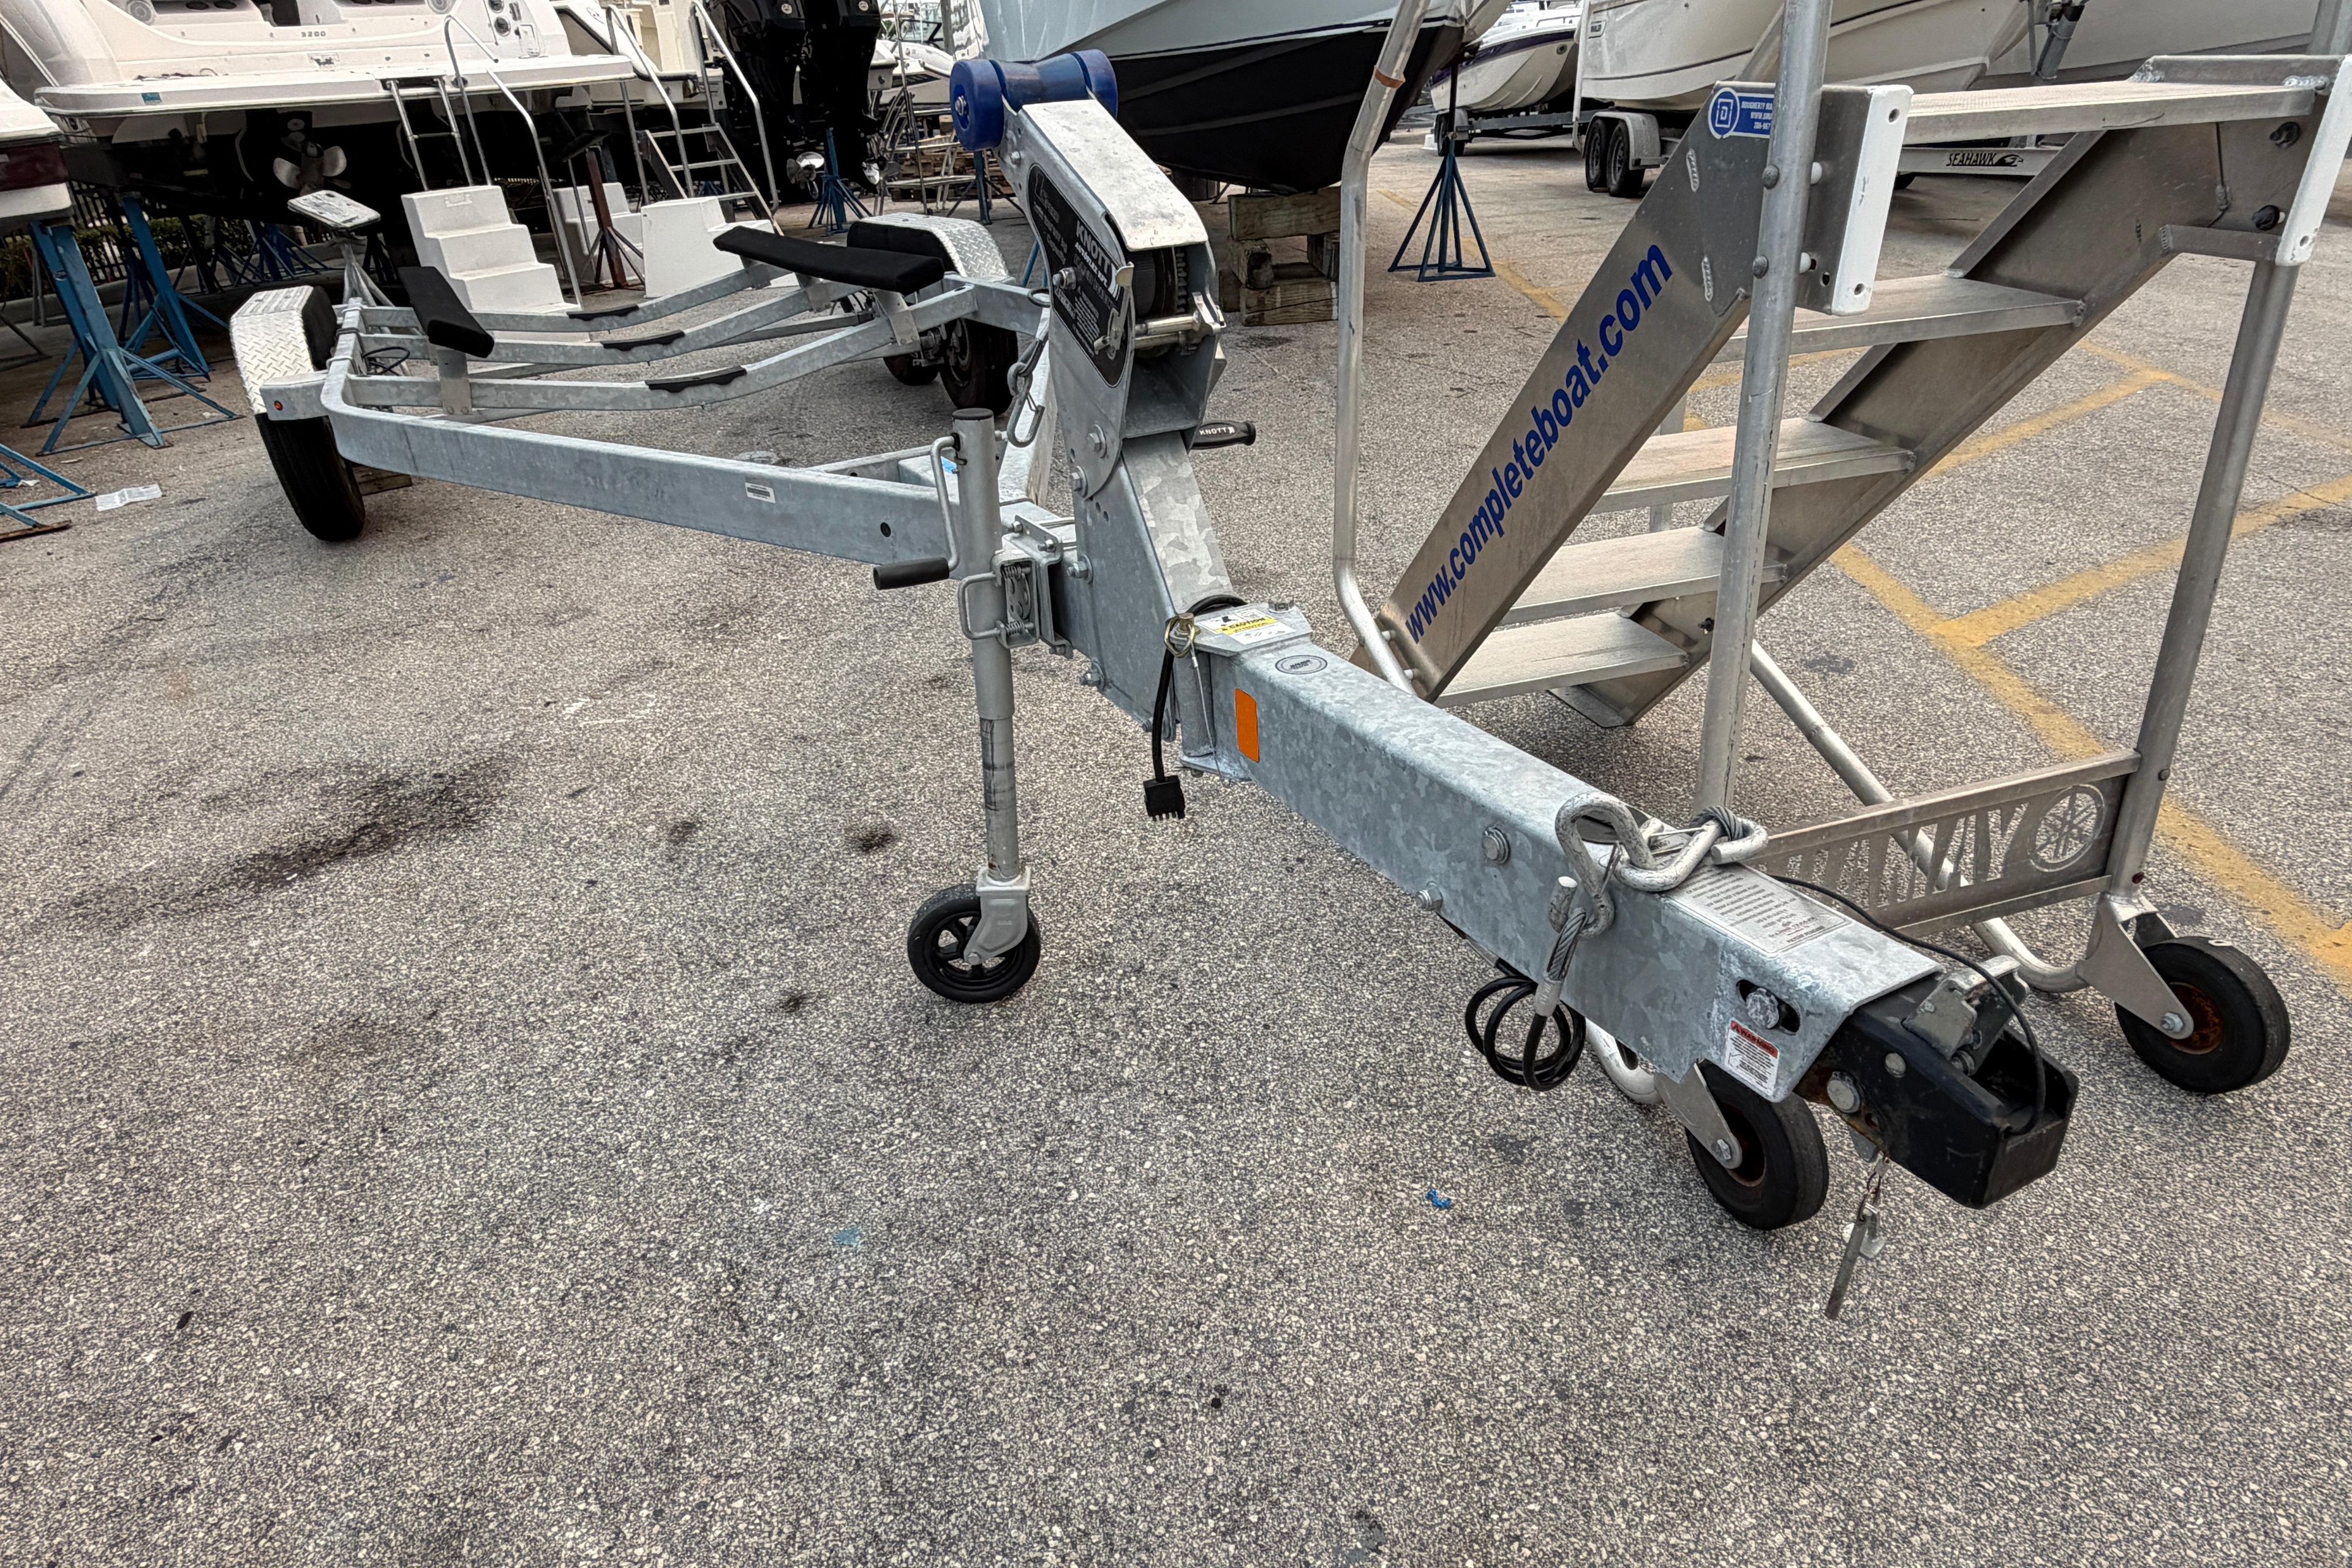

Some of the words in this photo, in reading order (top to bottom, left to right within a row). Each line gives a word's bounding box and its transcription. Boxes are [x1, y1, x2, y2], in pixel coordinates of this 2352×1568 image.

[1946, 152, 1997, 167] SEAHAWK
[1076, 219, 1111, 274] KNOTT
[1199, 426, 1227, 435] KNOTT
[1404, 245, 1673, 644] www.completeboat.com
